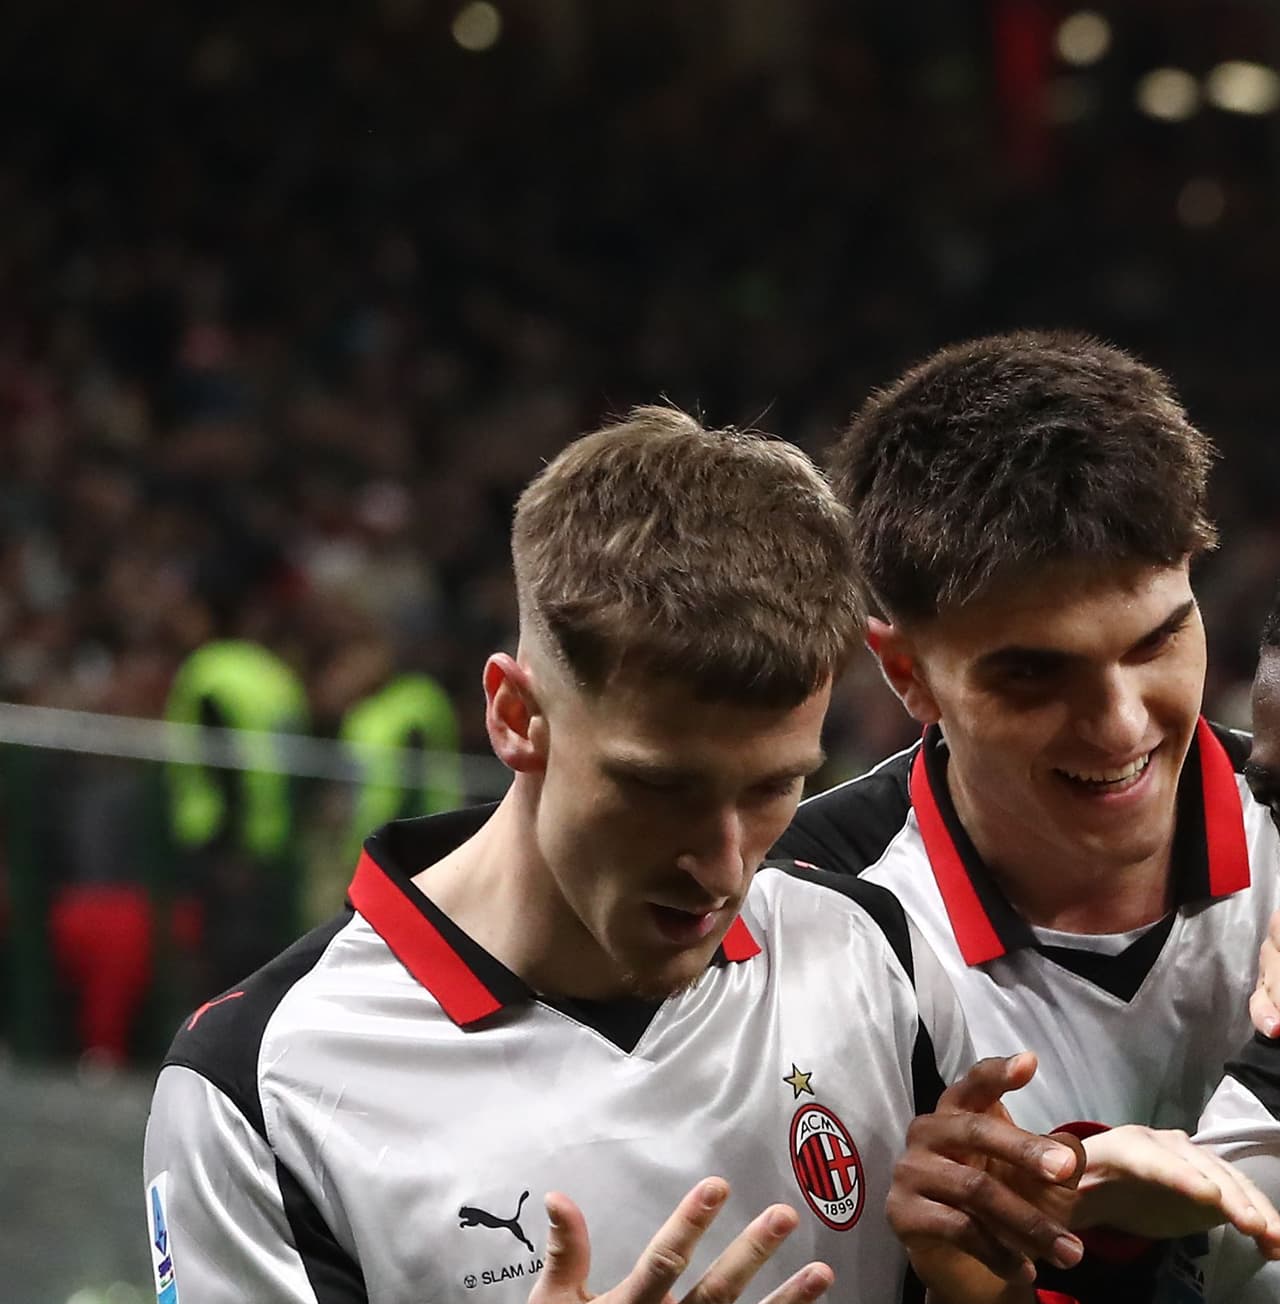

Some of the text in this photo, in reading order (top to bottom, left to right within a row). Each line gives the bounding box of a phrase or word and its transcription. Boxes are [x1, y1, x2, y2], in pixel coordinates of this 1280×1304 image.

[801, 1114, 836, 1140] ACM
[824, 1198, 855, 1216] 1899
[481, 1257, 546, 1285] SLAM JA
